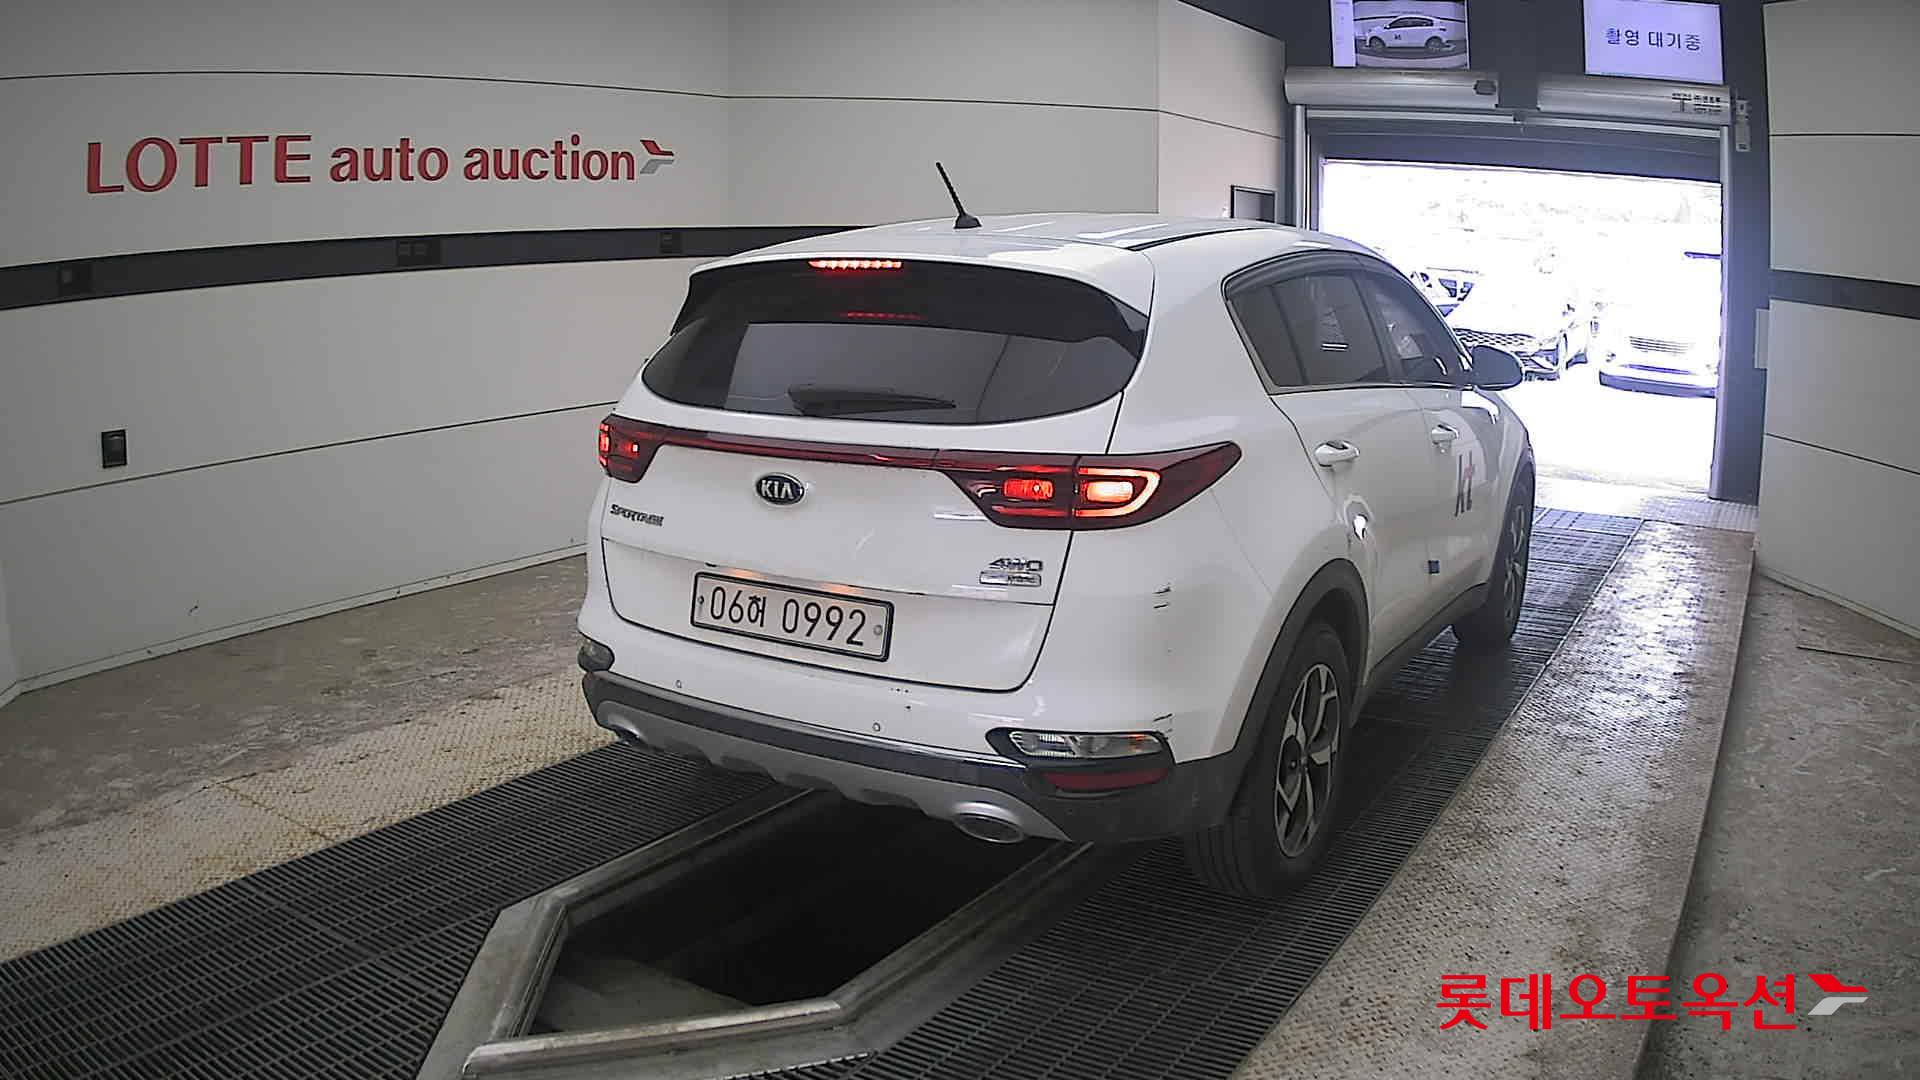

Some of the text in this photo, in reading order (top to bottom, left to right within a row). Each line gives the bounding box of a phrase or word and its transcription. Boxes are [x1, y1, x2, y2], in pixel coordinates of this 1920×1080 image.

[1605, 27, 1701, 51] 촬영 대기중
[88, 133, 636, 194] LOTTE auto auction
[761, 479, 794, 499] KIA
[710, 586, 866, 646] 06허 0992
